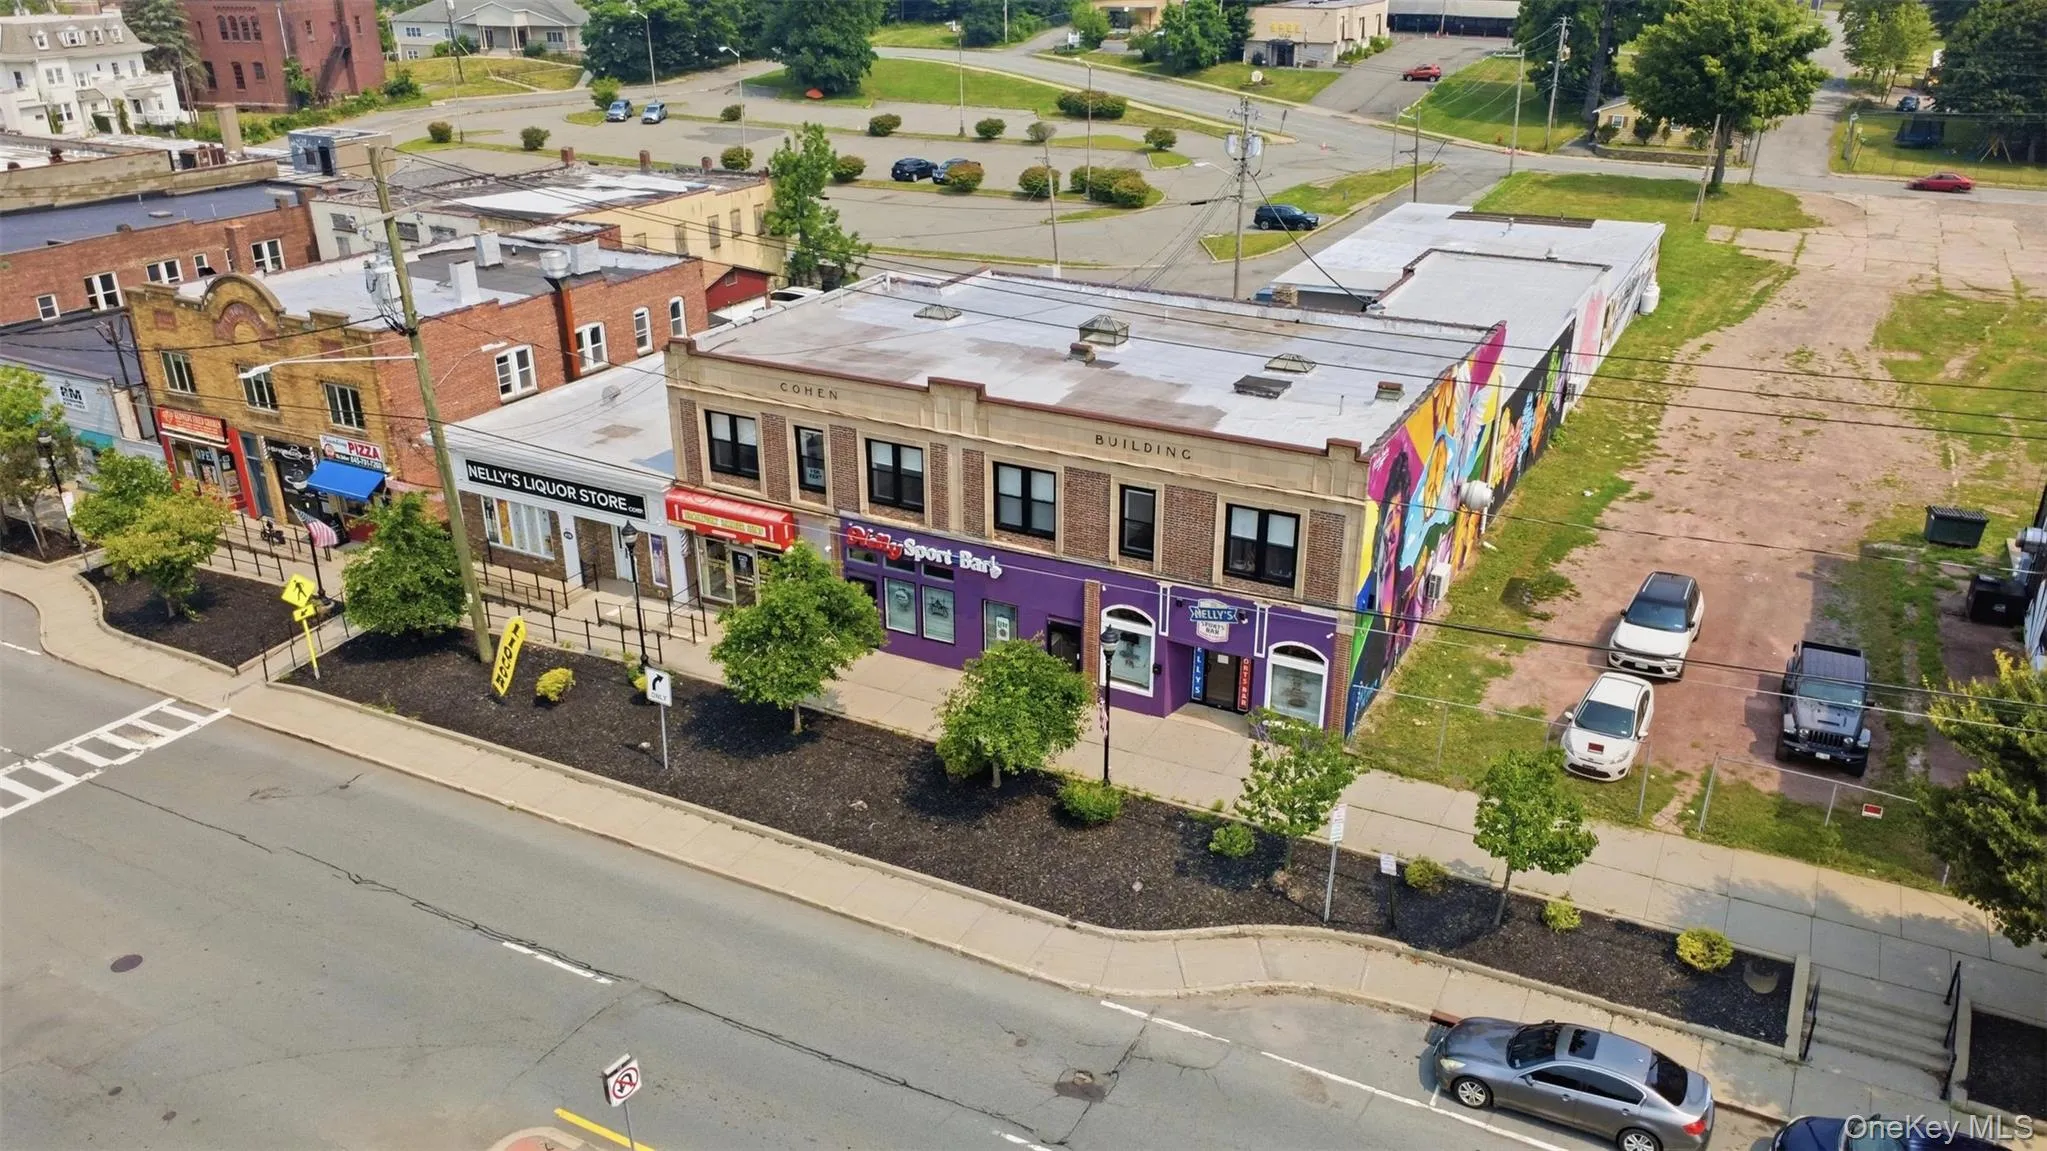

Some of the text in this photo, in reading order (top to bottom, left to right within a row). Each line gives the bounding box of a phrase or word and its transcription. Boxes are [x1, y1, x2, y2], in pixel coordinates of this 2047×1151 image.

[780, 382, 838, 400] COHEN
[347, 441, 380, 460] PIZZA
[1095, 434, 1191, 460] BUILDING
[467, 464, 521, 488] NELLY'S
[523, 475, 577, 500] LIQUOR
[579, 488, 628, 511] STORE
[904, 538, 953, 566] Sport
[1194, 609, 1234, 620] NELLY'S
